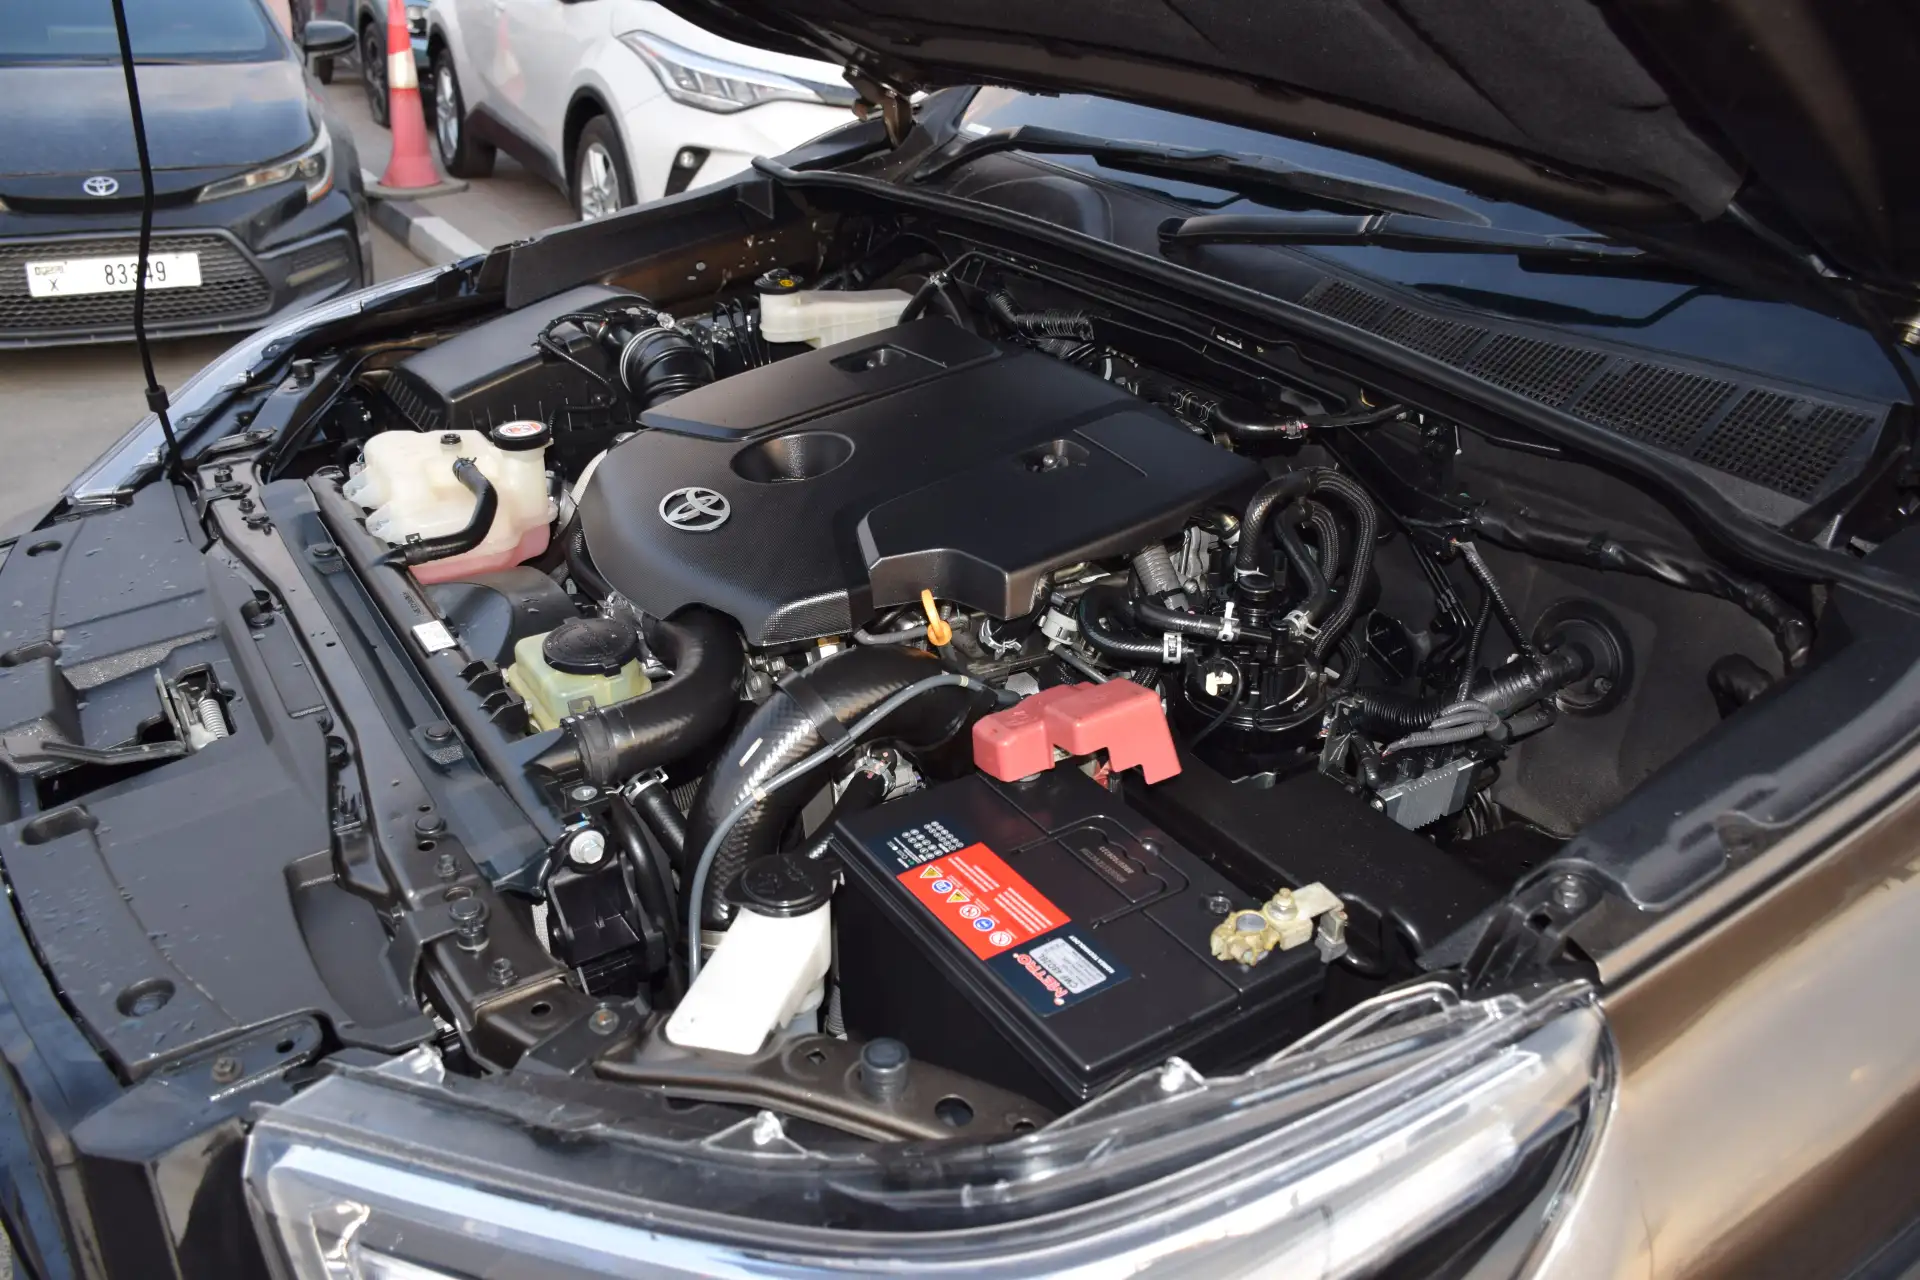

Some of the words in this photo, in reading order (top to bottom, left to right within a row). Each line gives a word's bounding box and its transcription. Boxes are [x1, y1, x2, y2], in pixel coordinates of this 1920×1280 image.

[48, 278, 60, 292] X
[104, 261, 167, 285] 83349
[1016, 953, 1069, 998] METRO
